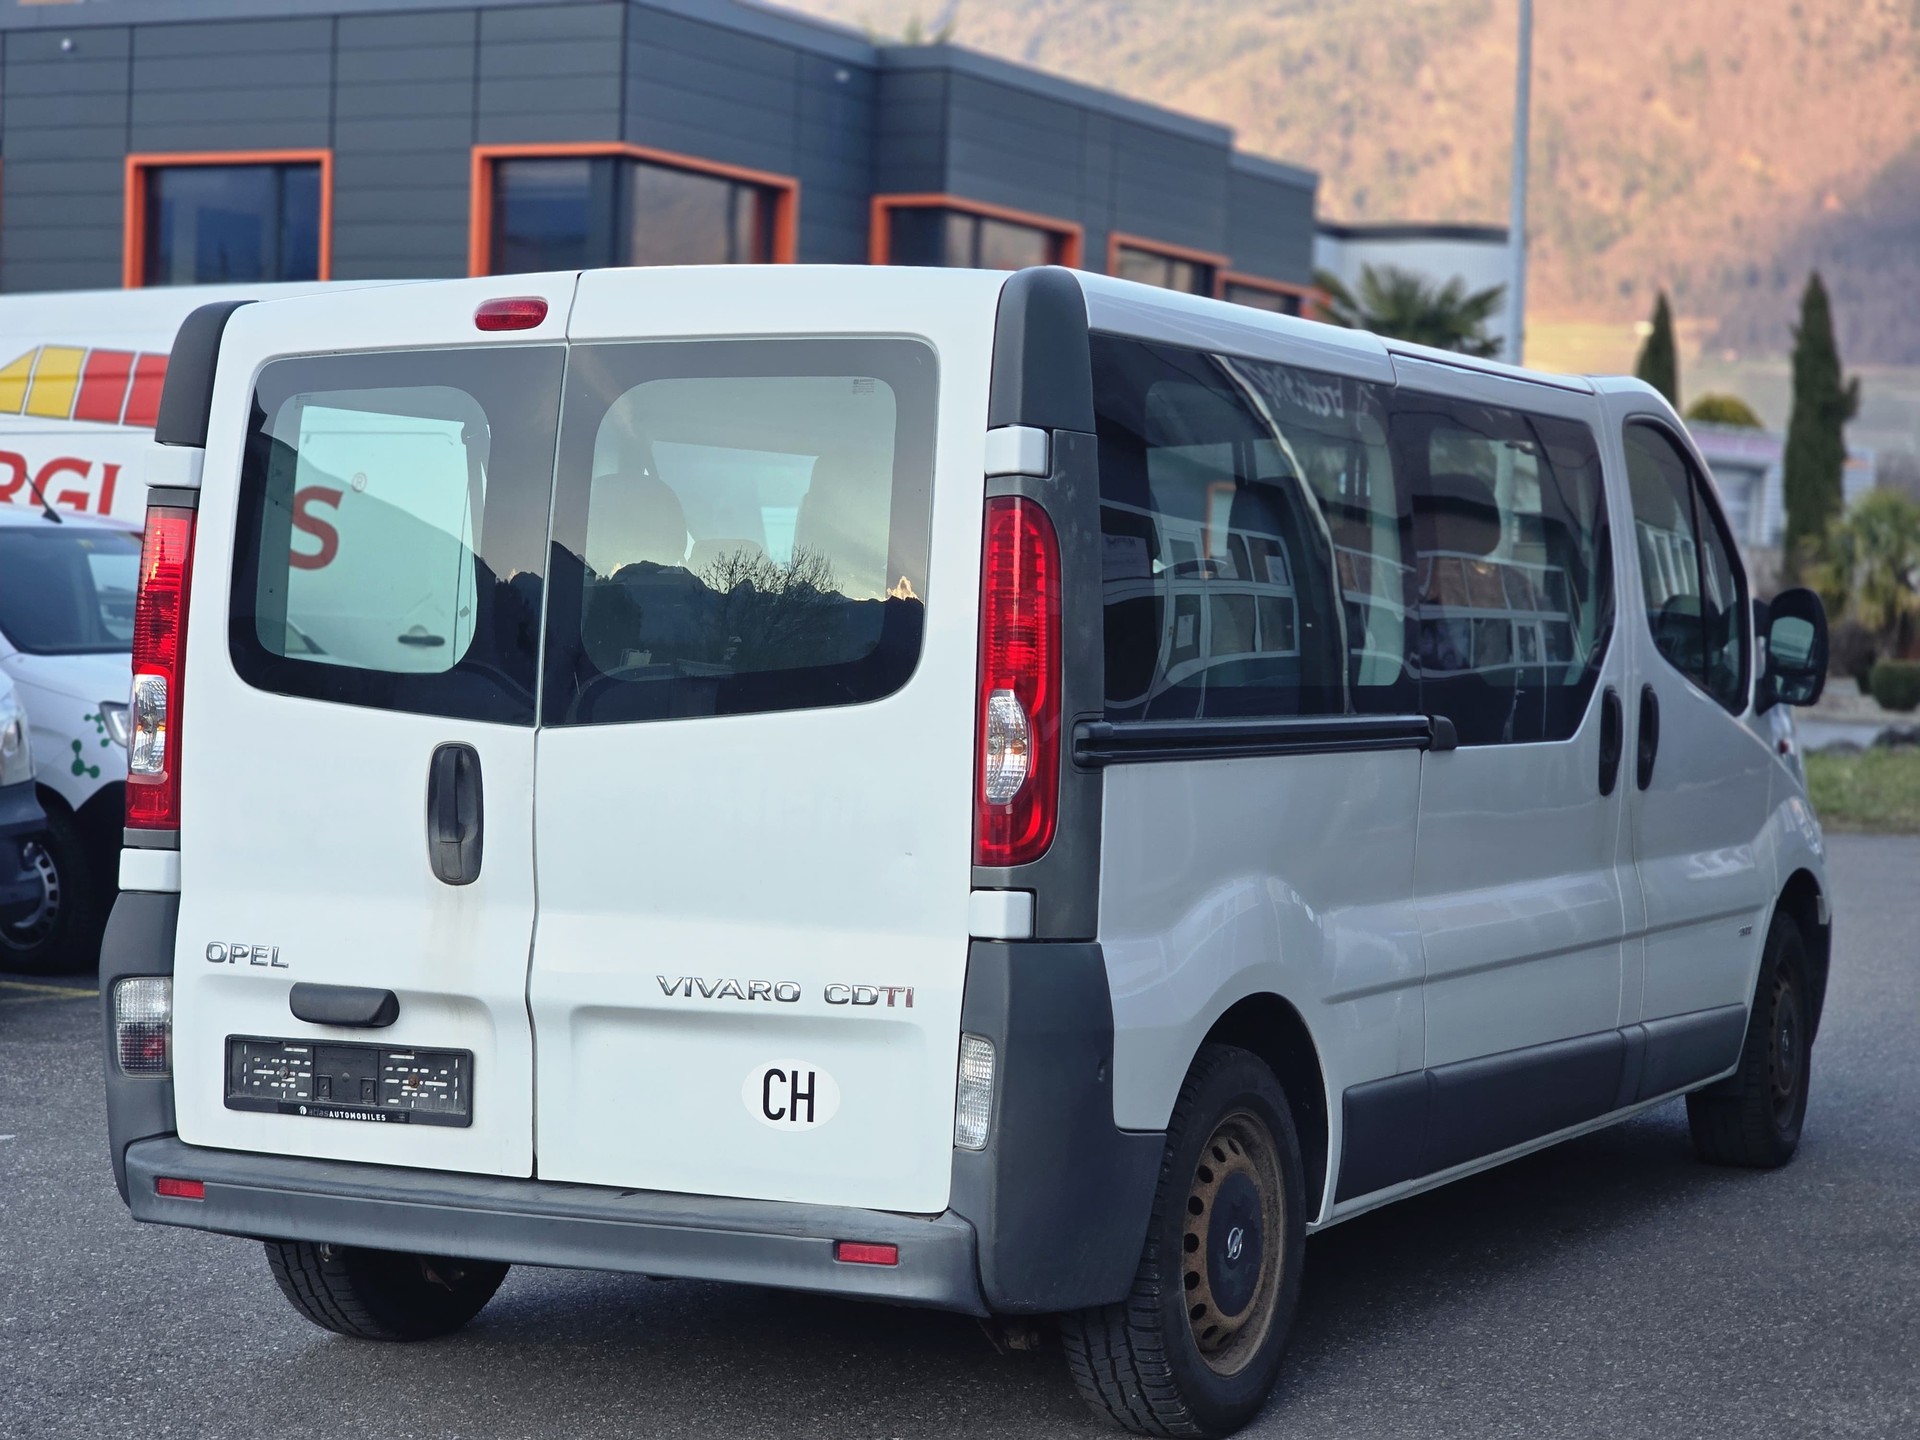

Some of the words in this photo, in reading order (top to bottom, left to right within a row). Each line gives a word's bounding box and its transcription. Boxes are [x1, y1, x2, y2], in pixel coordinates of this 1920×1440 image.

[205, 941, 289, 969] OPEL
[656, 975, 801, 1003] VIVARO
[824, 983, 914, 1008] CDTI
[762, 1068, 815, 1122] CH
